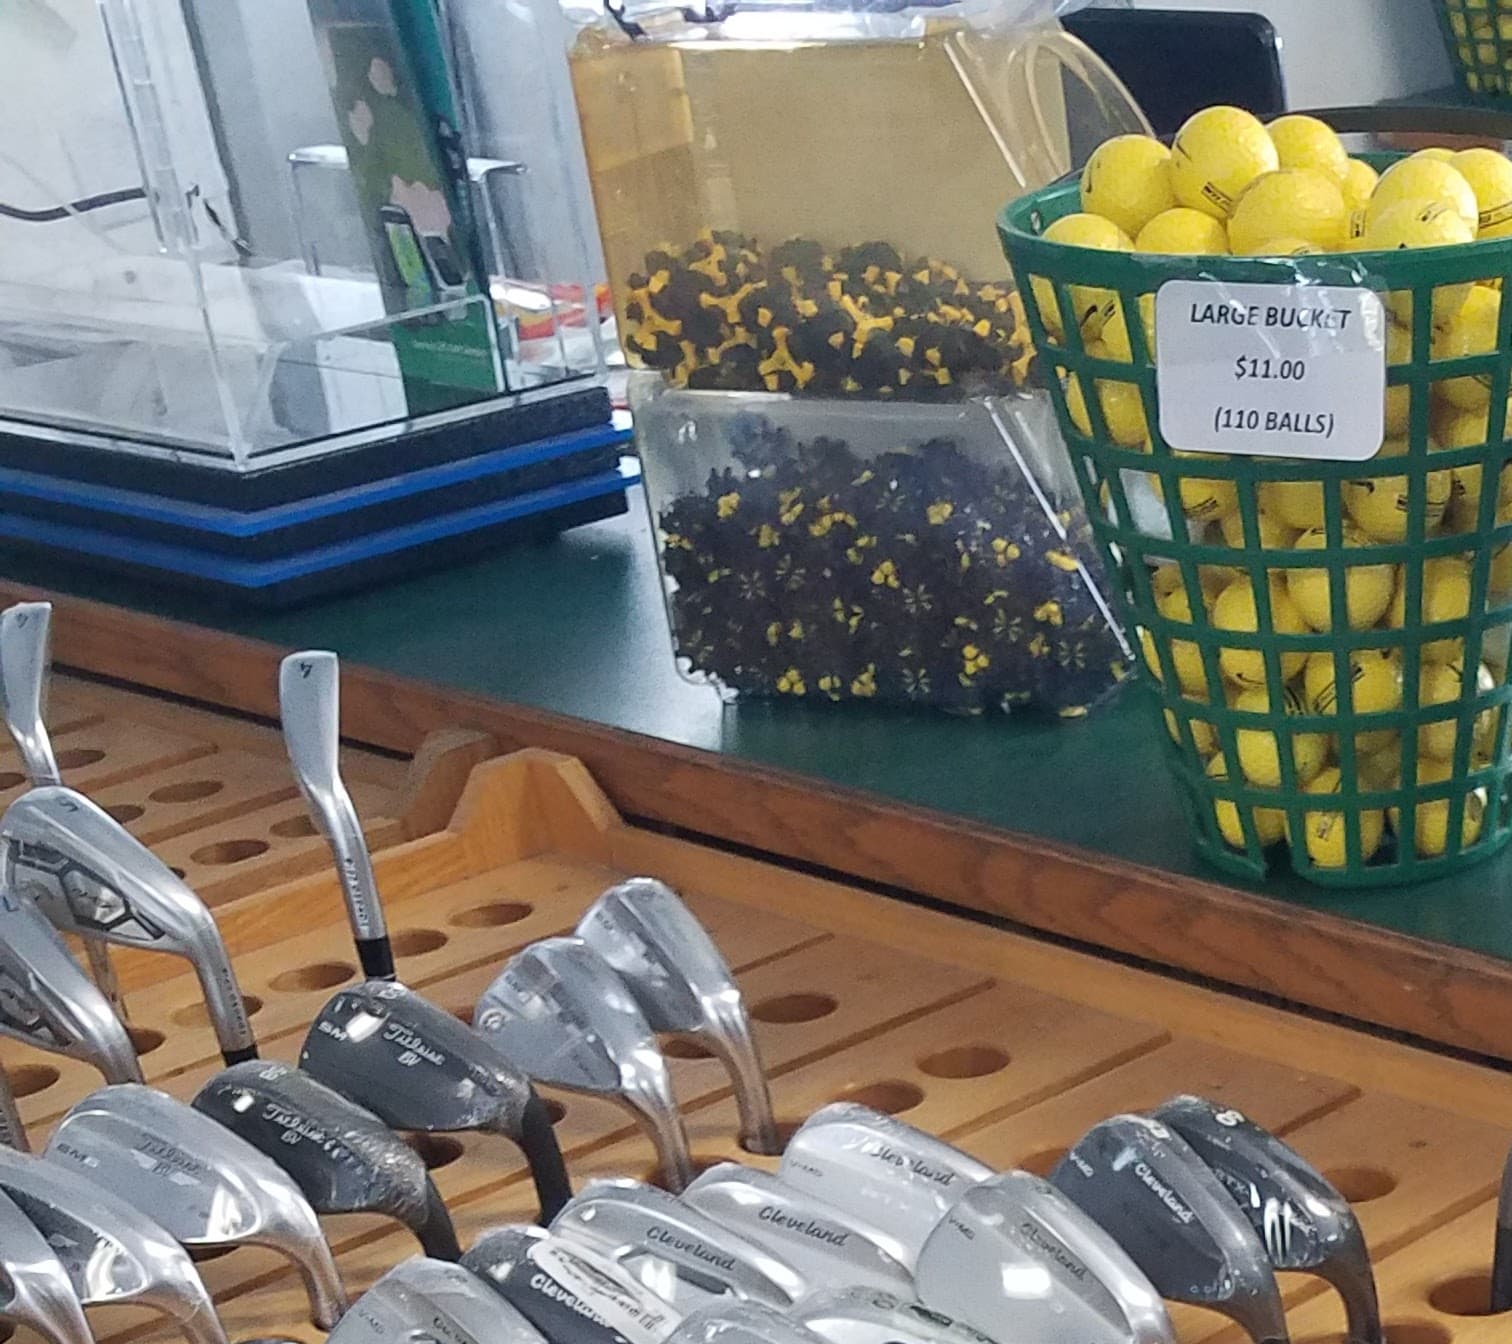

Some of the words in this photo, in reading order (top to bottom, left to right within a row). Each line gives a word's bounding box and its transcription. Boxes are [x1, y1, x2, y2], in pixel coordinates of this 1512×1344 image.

[1190, 302, 1259, 328] LARGE
[1264, 305, 1351, 331] BUCKET
[1233, 355, 1305, 382] $11.00
[1213, 407, 1260, 432] (110
[1264, 411, 1335, 438] BALLS)
[1134, 1162, 1196, 1224] Cleveland
[758, 1205, 850, 1248] Cleveland
[646, 1225, 737, 1272] Cleveland
